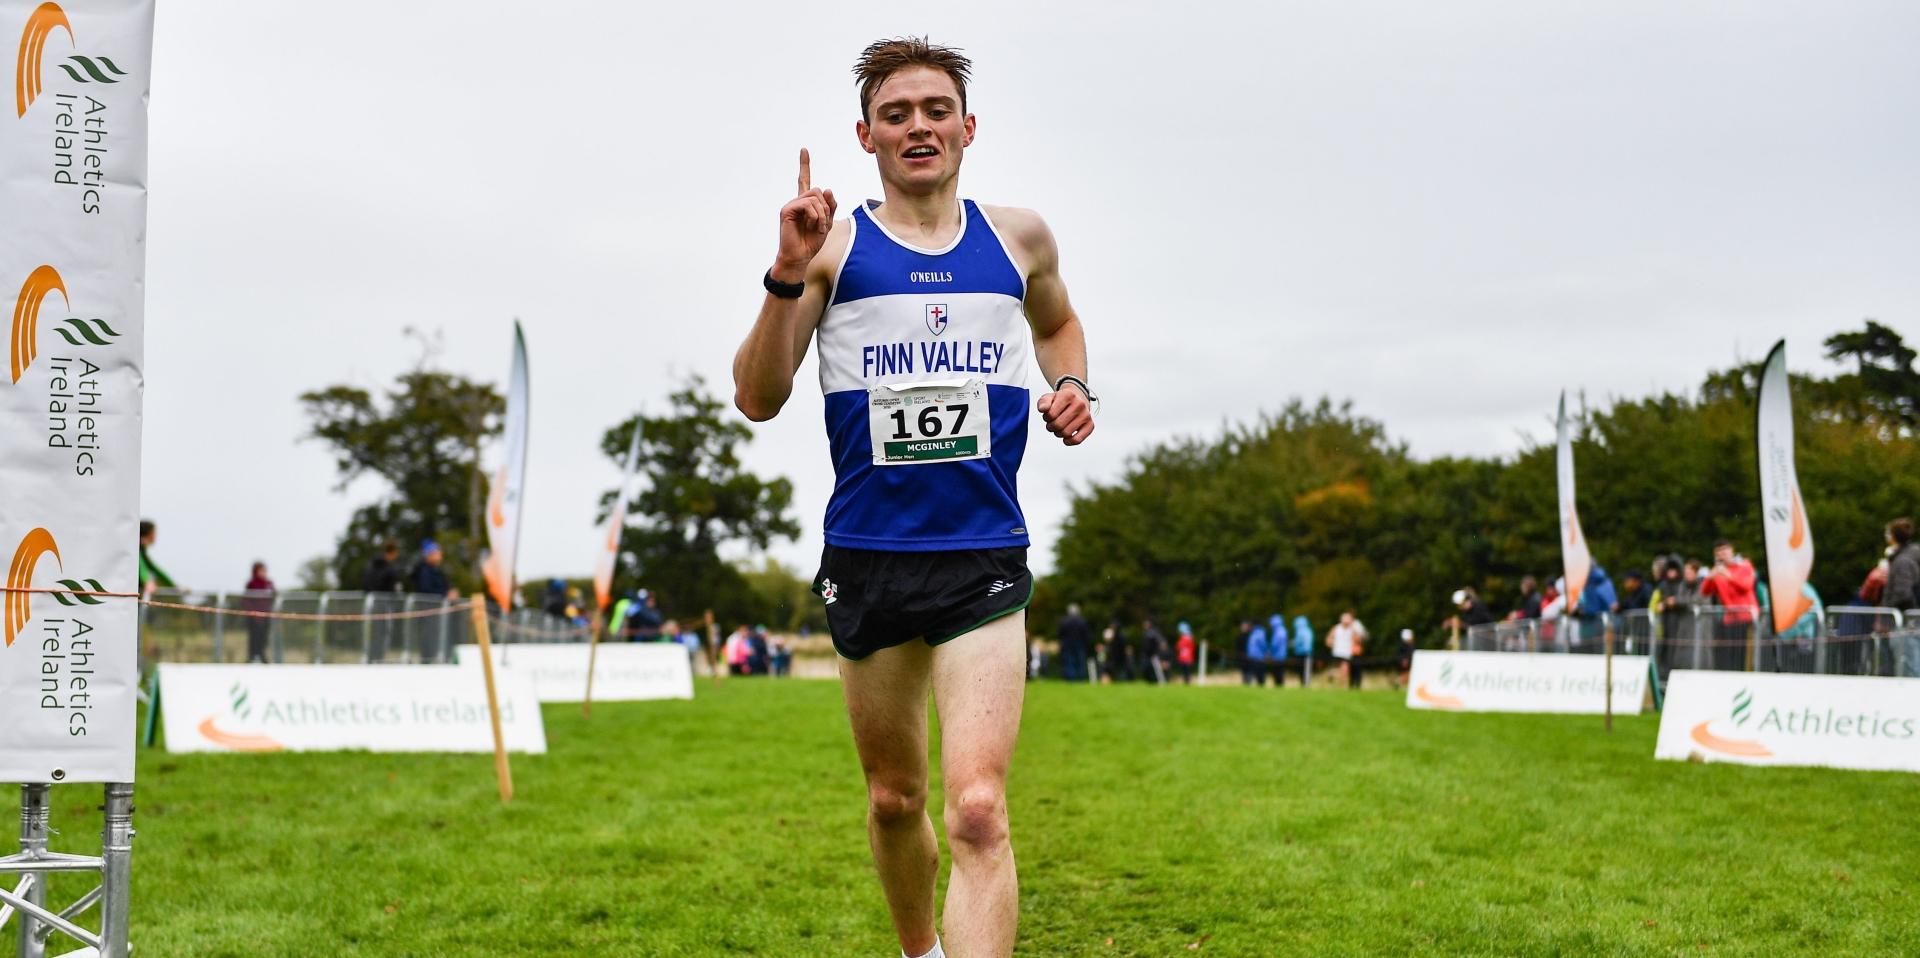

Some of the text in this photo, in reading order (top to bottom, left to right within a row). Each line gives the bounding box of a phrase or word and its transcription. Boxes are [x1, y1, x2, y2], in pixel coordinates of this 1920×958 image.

[54, 93, 80, 185] Ireland
[83, 95, 108, 215] Athletics
[910, 271, 953, 283] O'NEILLS
[863, 340, 1005, 378] FINN VALLEY
[48, 357, 74, 448] Ireland
[76, 357, 102, 476] Athletics
[889, 403, 970, 440] 167
[906, 440, 957, 452] MCGINLEY
[41, 618, 66, 709] Ireland
[69, 618, 95, 736] Athletics
[1458, 671, 1552, 693] Athletics
[261, 698, 401, 724] Athletics
[1757, 706, 1915, 739] Athletics
